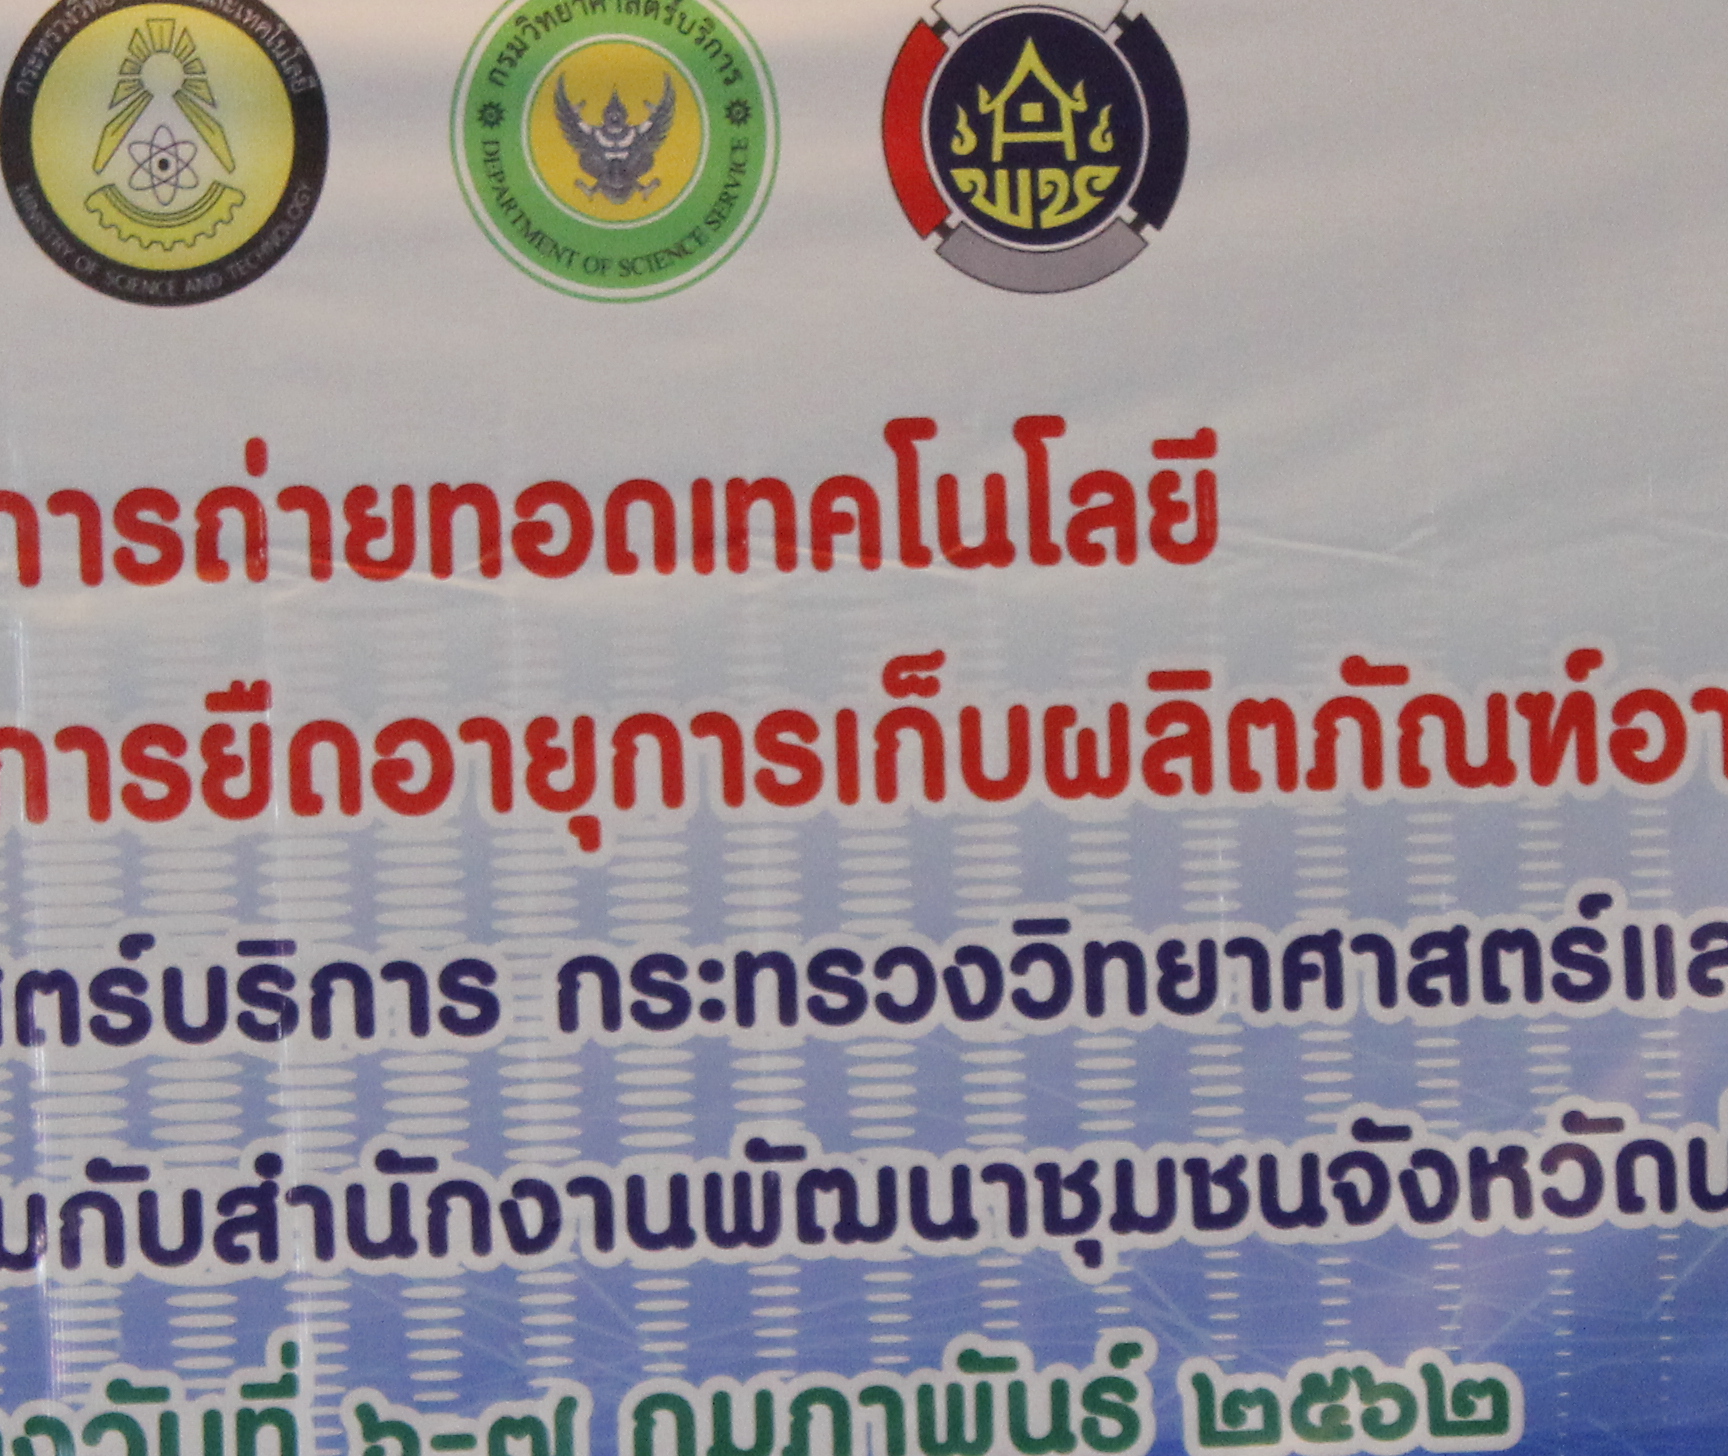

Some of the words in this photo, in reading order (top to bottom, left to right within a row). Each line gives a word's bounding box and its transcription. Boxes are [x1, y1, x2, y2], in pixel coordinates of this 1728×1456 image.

[481, 139, 580, 271] DEPARTMENT
[582, 256, 612, 276] OF
[618, 225, 710, 278] SCIENCE
[703, 136, 750, 232] SERVICE
[1190, 1361, 1515, 1448] ๒๕๖๒
